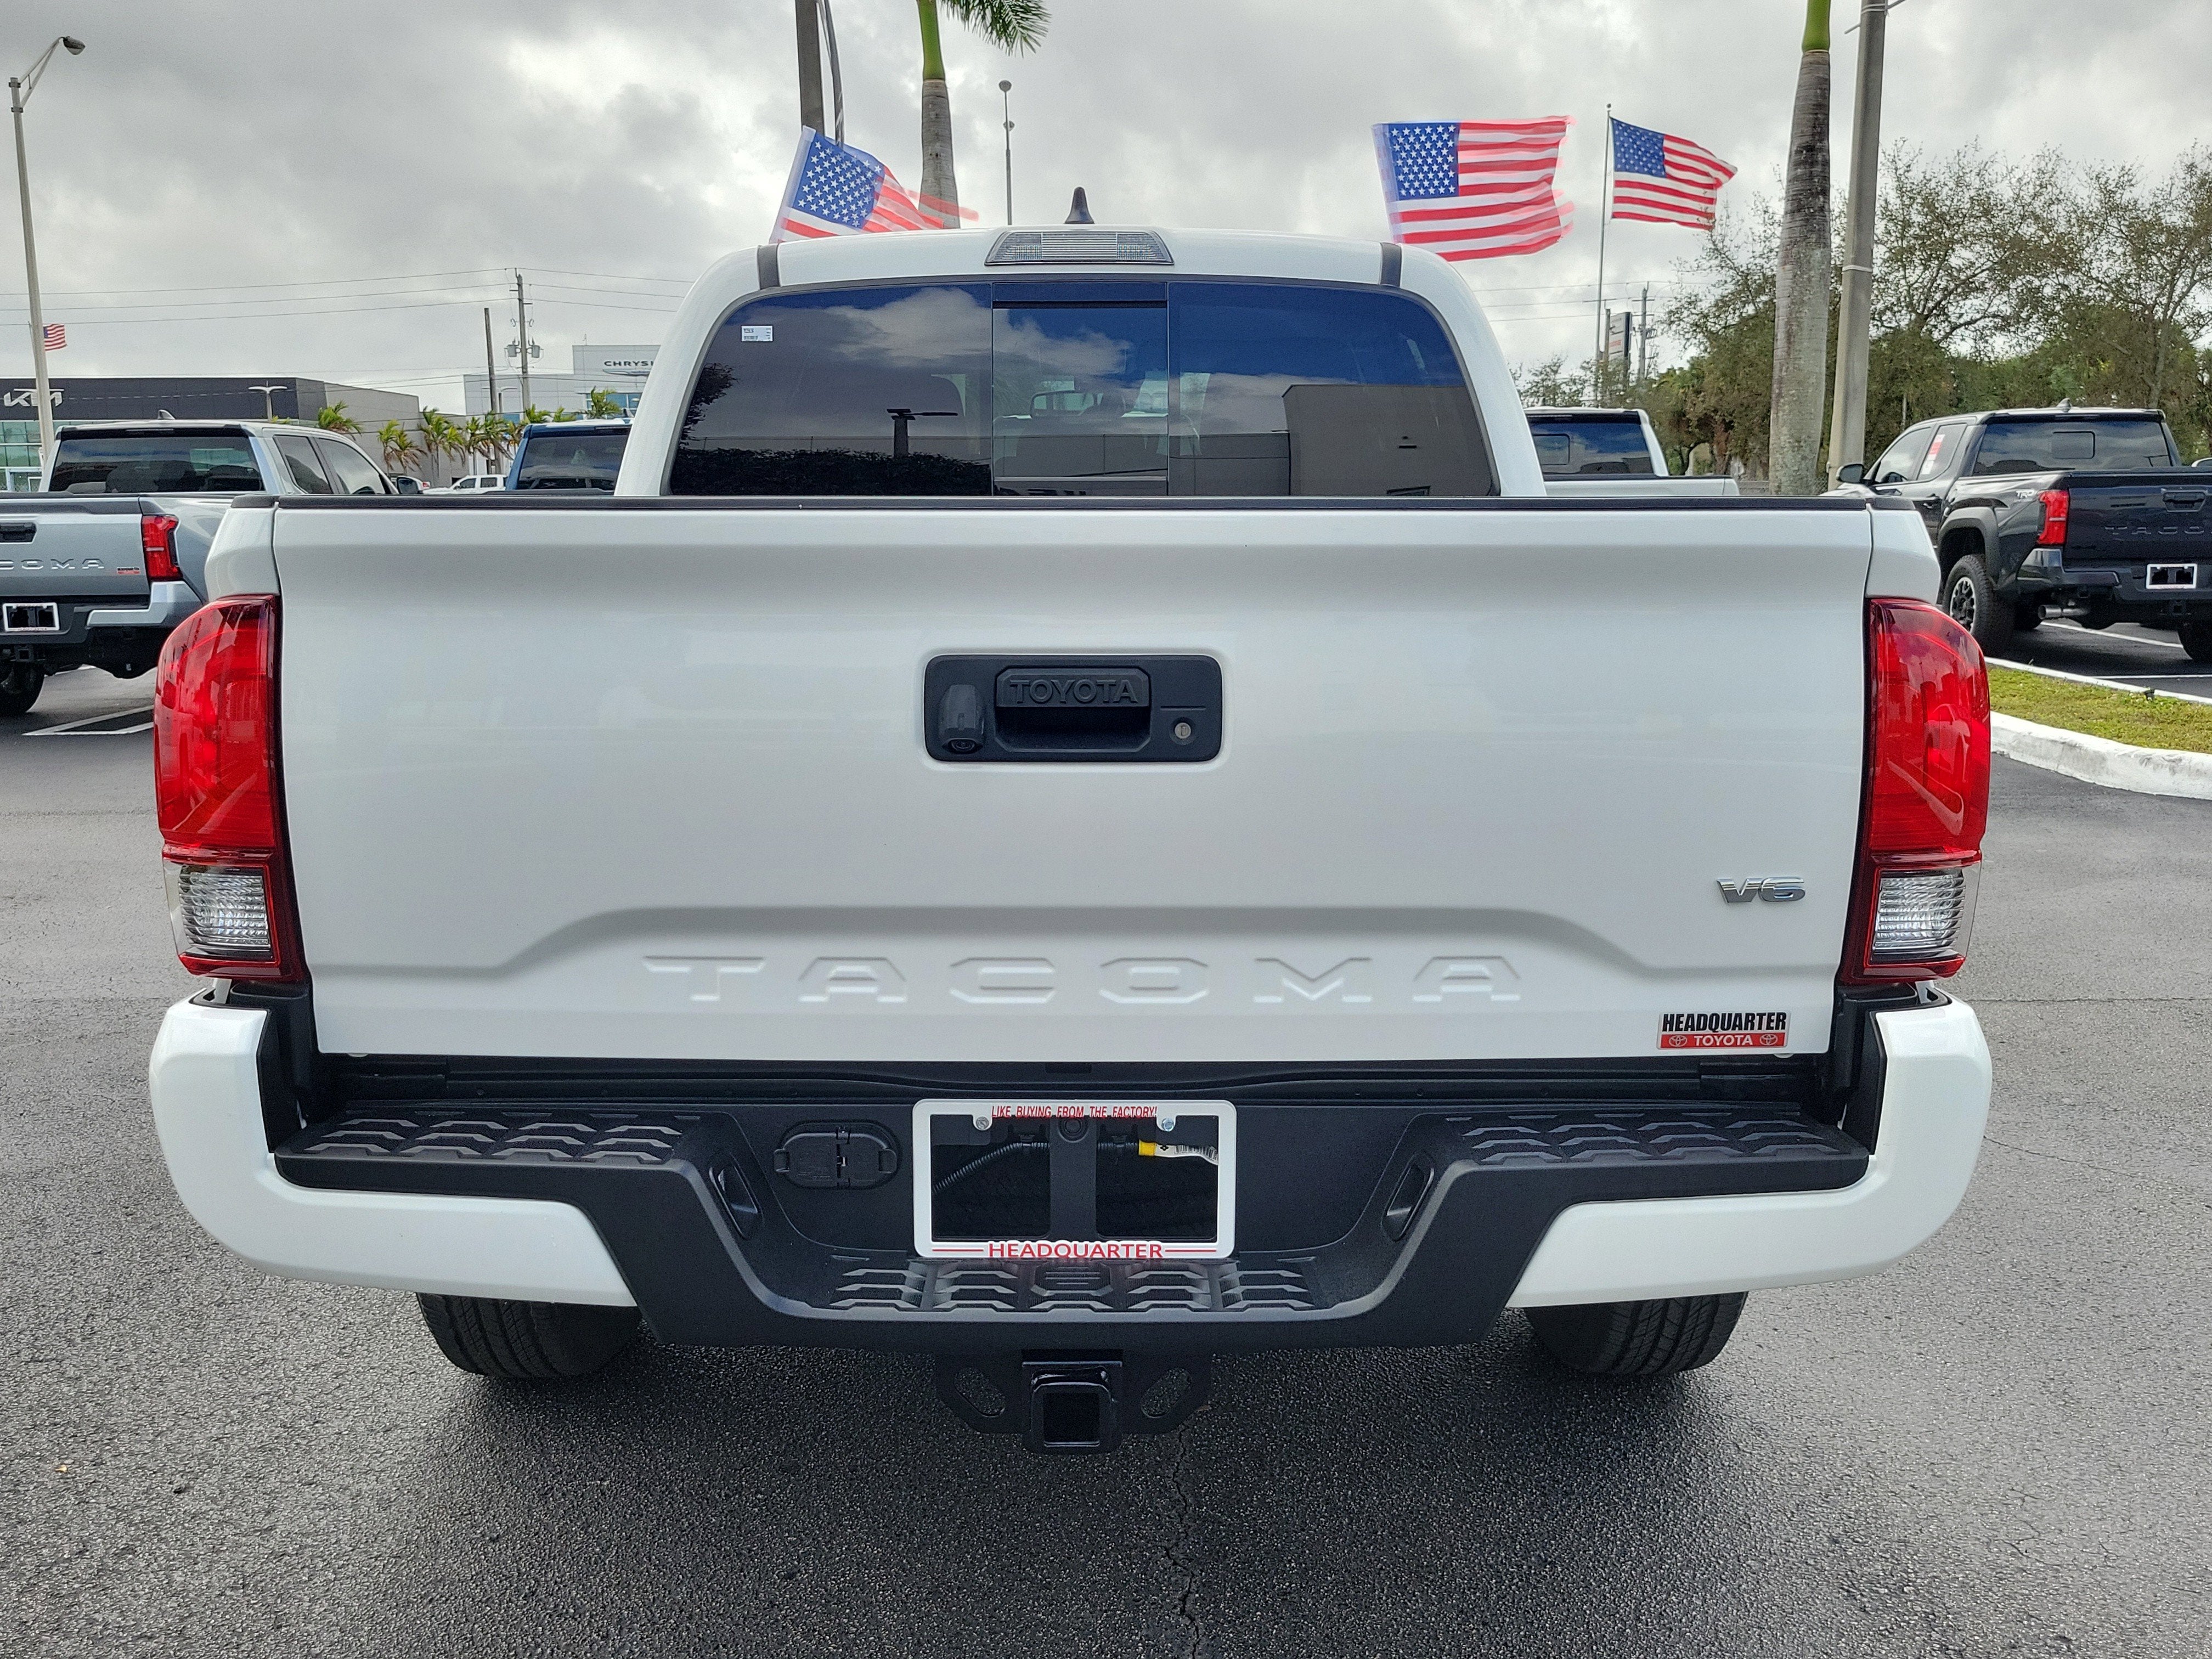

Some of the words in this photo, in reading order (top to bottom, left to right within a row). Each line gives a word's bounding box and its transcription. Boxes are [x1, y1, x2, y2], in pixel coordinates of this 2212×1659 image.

[2104, 526, 2212, 535] TACO
[1010, 679, 1138, 704] TOYOTA
[1717, 877, 1805, 904] V6
[642, 956, 1521, 1003] TACOMA
[1662, 1012, 1787, 1032] HEADQUARTER
[1694, 1034, 1753, 1046] TOYOTA
[991, 1105, 1011, 1118] LIKE
[1017, 1105, 1052, 1118] BUYING
[1056, 1105, 1084, 1118] FROM
[1090, 1105, 1107, 1118] THE
[1111, 1105, 1158, 1118] FACTORY!
[988, 1243, 1163, 1258] HEADQUARTER
